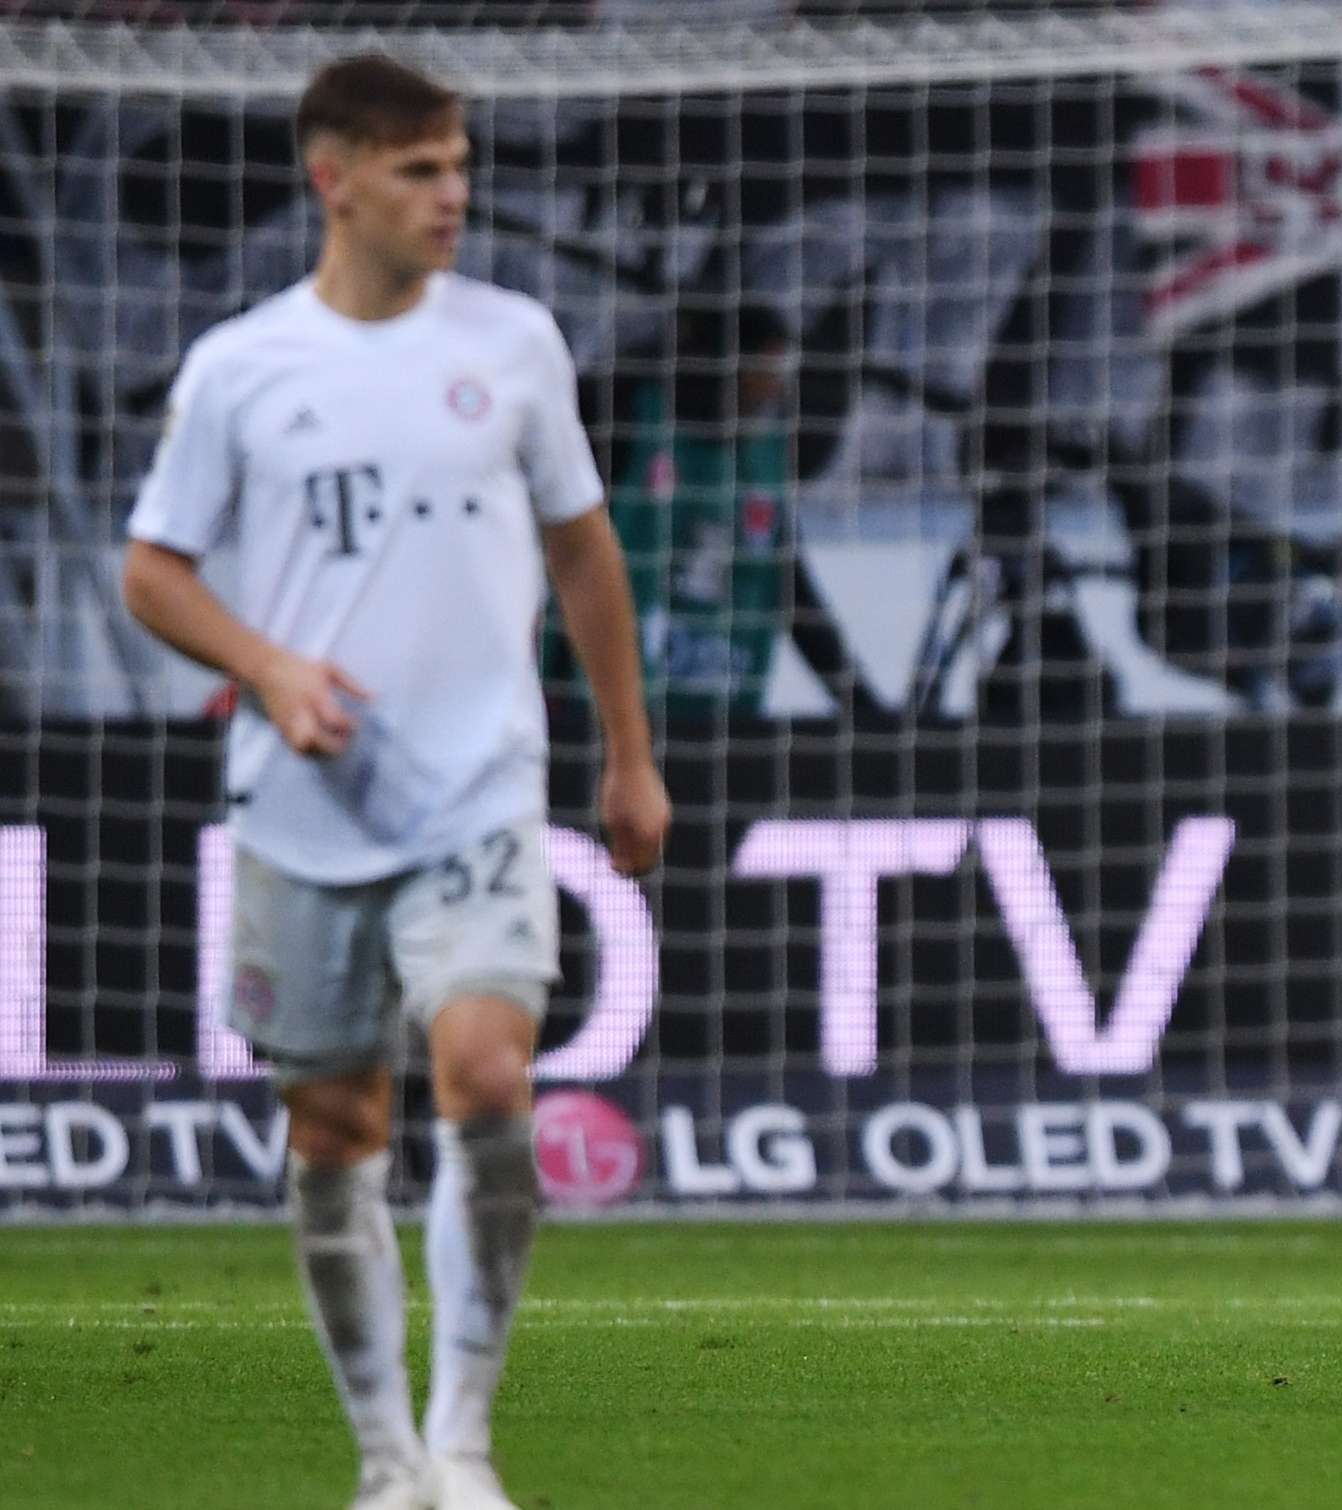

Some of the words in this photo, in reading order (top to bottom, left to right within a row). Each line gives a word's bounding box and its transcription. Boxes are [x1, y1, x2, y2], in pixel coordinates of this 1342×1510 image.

[733, 817, 1236, 1076] TV
[143, 1101, 291, 1187] TV
[663, 1103, 816, 1193] LG
[861, 1102, 1172, 1191] OLED
